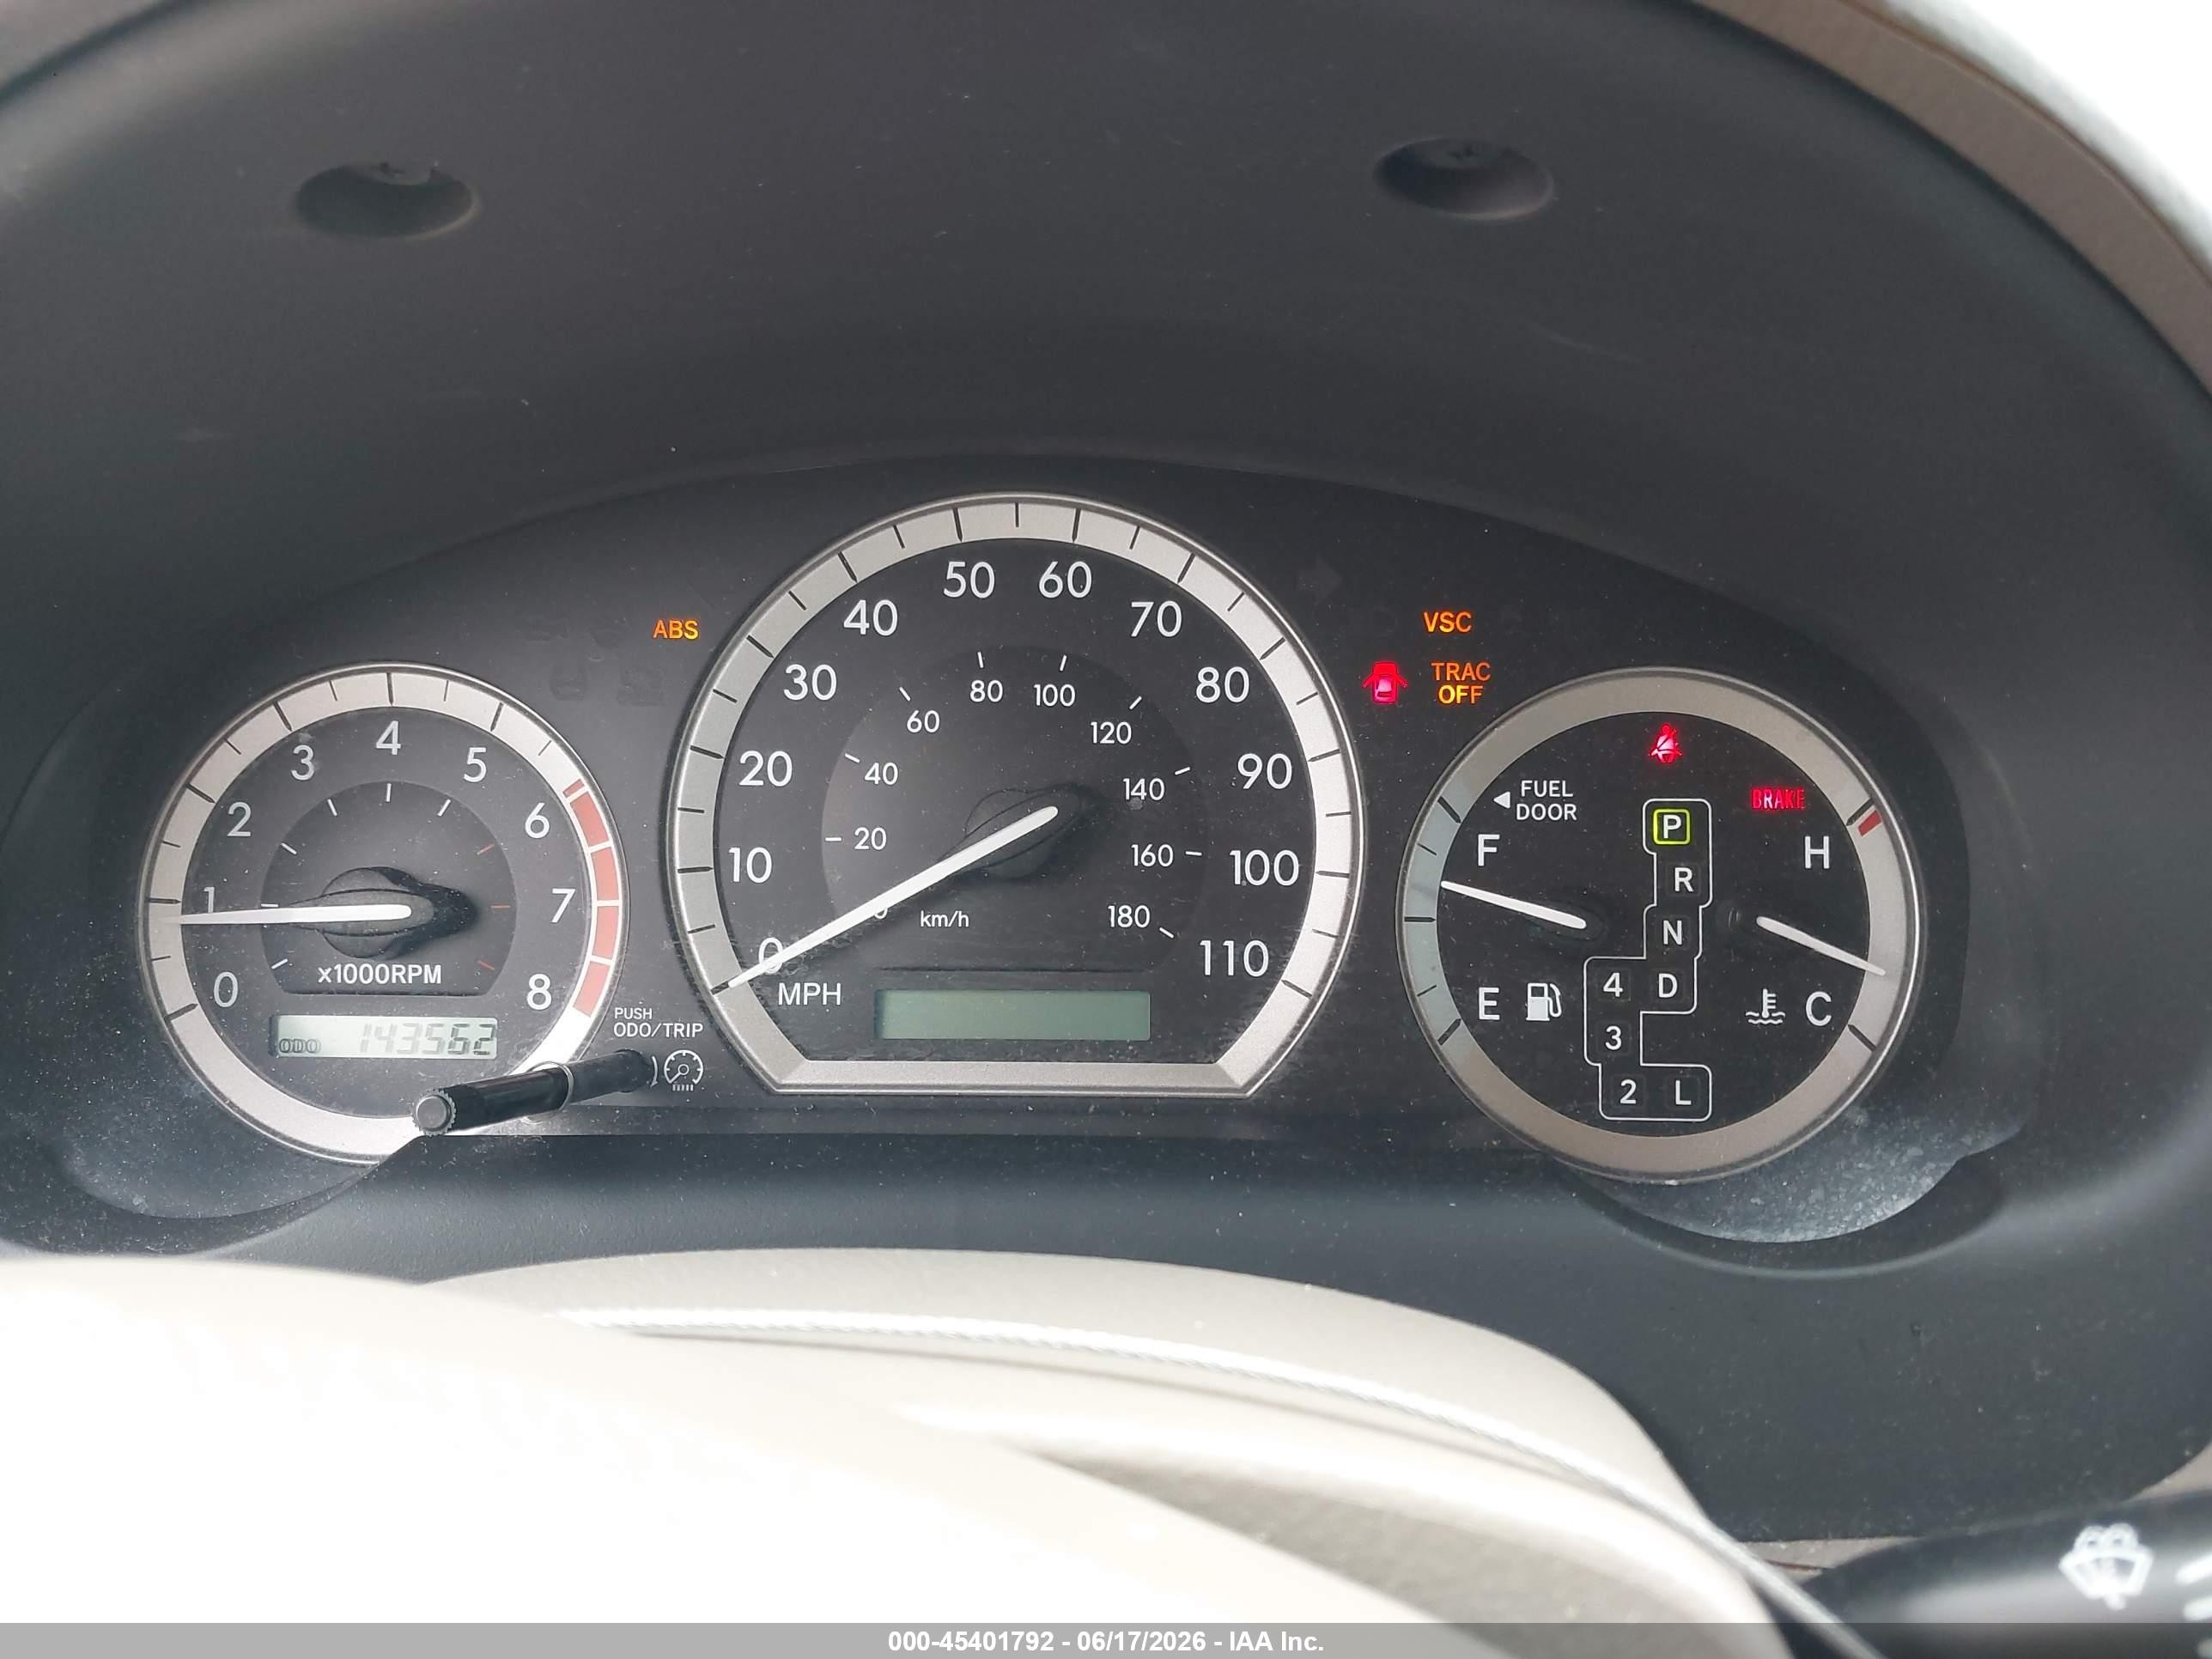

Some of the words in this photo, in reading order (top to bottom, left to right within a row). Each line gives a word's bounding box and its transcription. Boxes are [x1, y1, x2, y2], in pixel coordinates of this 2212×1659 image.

[944, 562, 994, 598] 50
[1039, 562, 1091, 598] 60
[653, 620, 698, 639] ABS
[844, 600, 897, 635] 40
[1131, 601, 1182, 636] 70
[1425, 611, 1471, 632] VSC
[784, 665, 836, 700] 30
[1432, 663, 1490, 680] TRAC
[970, 680, 1002, 702] 80
[1035, 684, 1075, 706] 100
[1196, 667, 1249, 702] 80
[1439, 685, 1482, 703] OFF
[907, 710, 939, 732] 60
[1091, 722, 1131, 744] 120
[376, 721, 400, 755] 4
[292, 745, 313, 780] 3
[465, 748, 486, 781] 5
[739, 750, 792, 786] 20
[865, 763, 897, 785] 40
[1237, 754, 1291, 788] 90
[1123, 778, 1164, 800] 140
[1522, 781, 1573, 797] FUEL
[1753, 788, 1805, 811] BRAKE
[228, 802, 251, 836] 2
[526, 803, 549, 838] 6
[1517, 804, 1576, 820] DOOR
[855, 828, 886, 849] 20
[1664, 817, 1680, 837] P
[1132, 844, 1173, 866] 160
[1479, 835, 1499, 866] F
[1805, 836, 1829, 868] H
[728, 848, 771, 883] 10
[1231, 850, 1298, 885] 100
[1675, 867, 1692, 891] R
[203, 886, 216, 913] 1
[551, 889, 575, 922] 7
[920, 909, 969, 928] km/h
[1109, 905, 1150, 927] 180
[1664, 921, 1681, 945] N
[758, 938, 783, 975] 0
[1200, 940, 1268, 976] 110
[319, 963, 441, 983] x1000RPM
[1604, 973, 1622, 996] 4
[214, 972, 238, 1007] 0
[527, 974, 551, 1010] 8
[779, 983, 841, 1005] MPH
[1659, 974, 1677, 997] D
[615, 1007, 652, 1019] PUSH
[1480, 988, 1499, 1019] E
[1806, 992, 1831, 1025] C
[360, 1023, 496, 1055] 143562
[614, 1023, 702, 1037] ODO/TRIP
[1606, 1026, 1621, 1049] 3
[280, 1039, 321, 1054] ODO
[1620, 1079, 1636, 1103] 2
[1676, 1080, 1691, 1104] L
